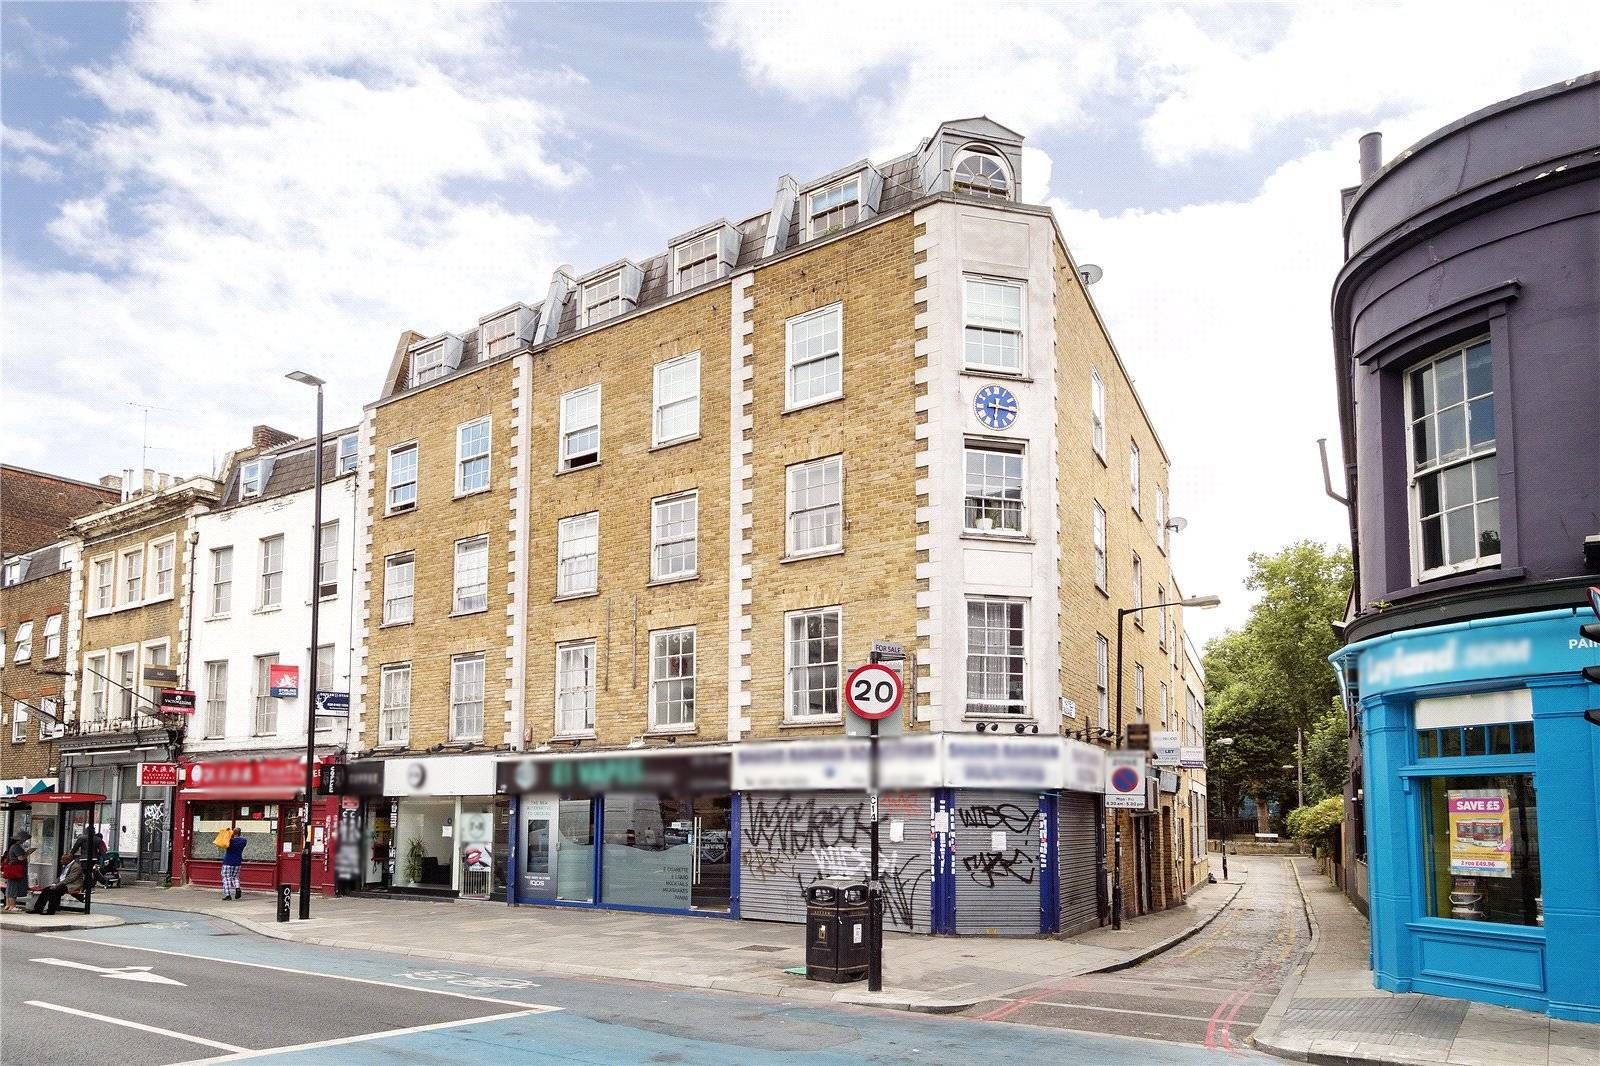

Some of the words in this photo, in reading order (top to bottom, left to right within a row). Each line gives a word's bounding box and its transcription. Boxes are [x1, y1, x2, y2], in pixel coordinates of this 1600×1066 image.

[875, 644, 886, 652] FOR
[854, 679, 894, 704] 20
[1456, 801, 1485, 811] SAVE
[1486, 800, 1500, 811] £5
